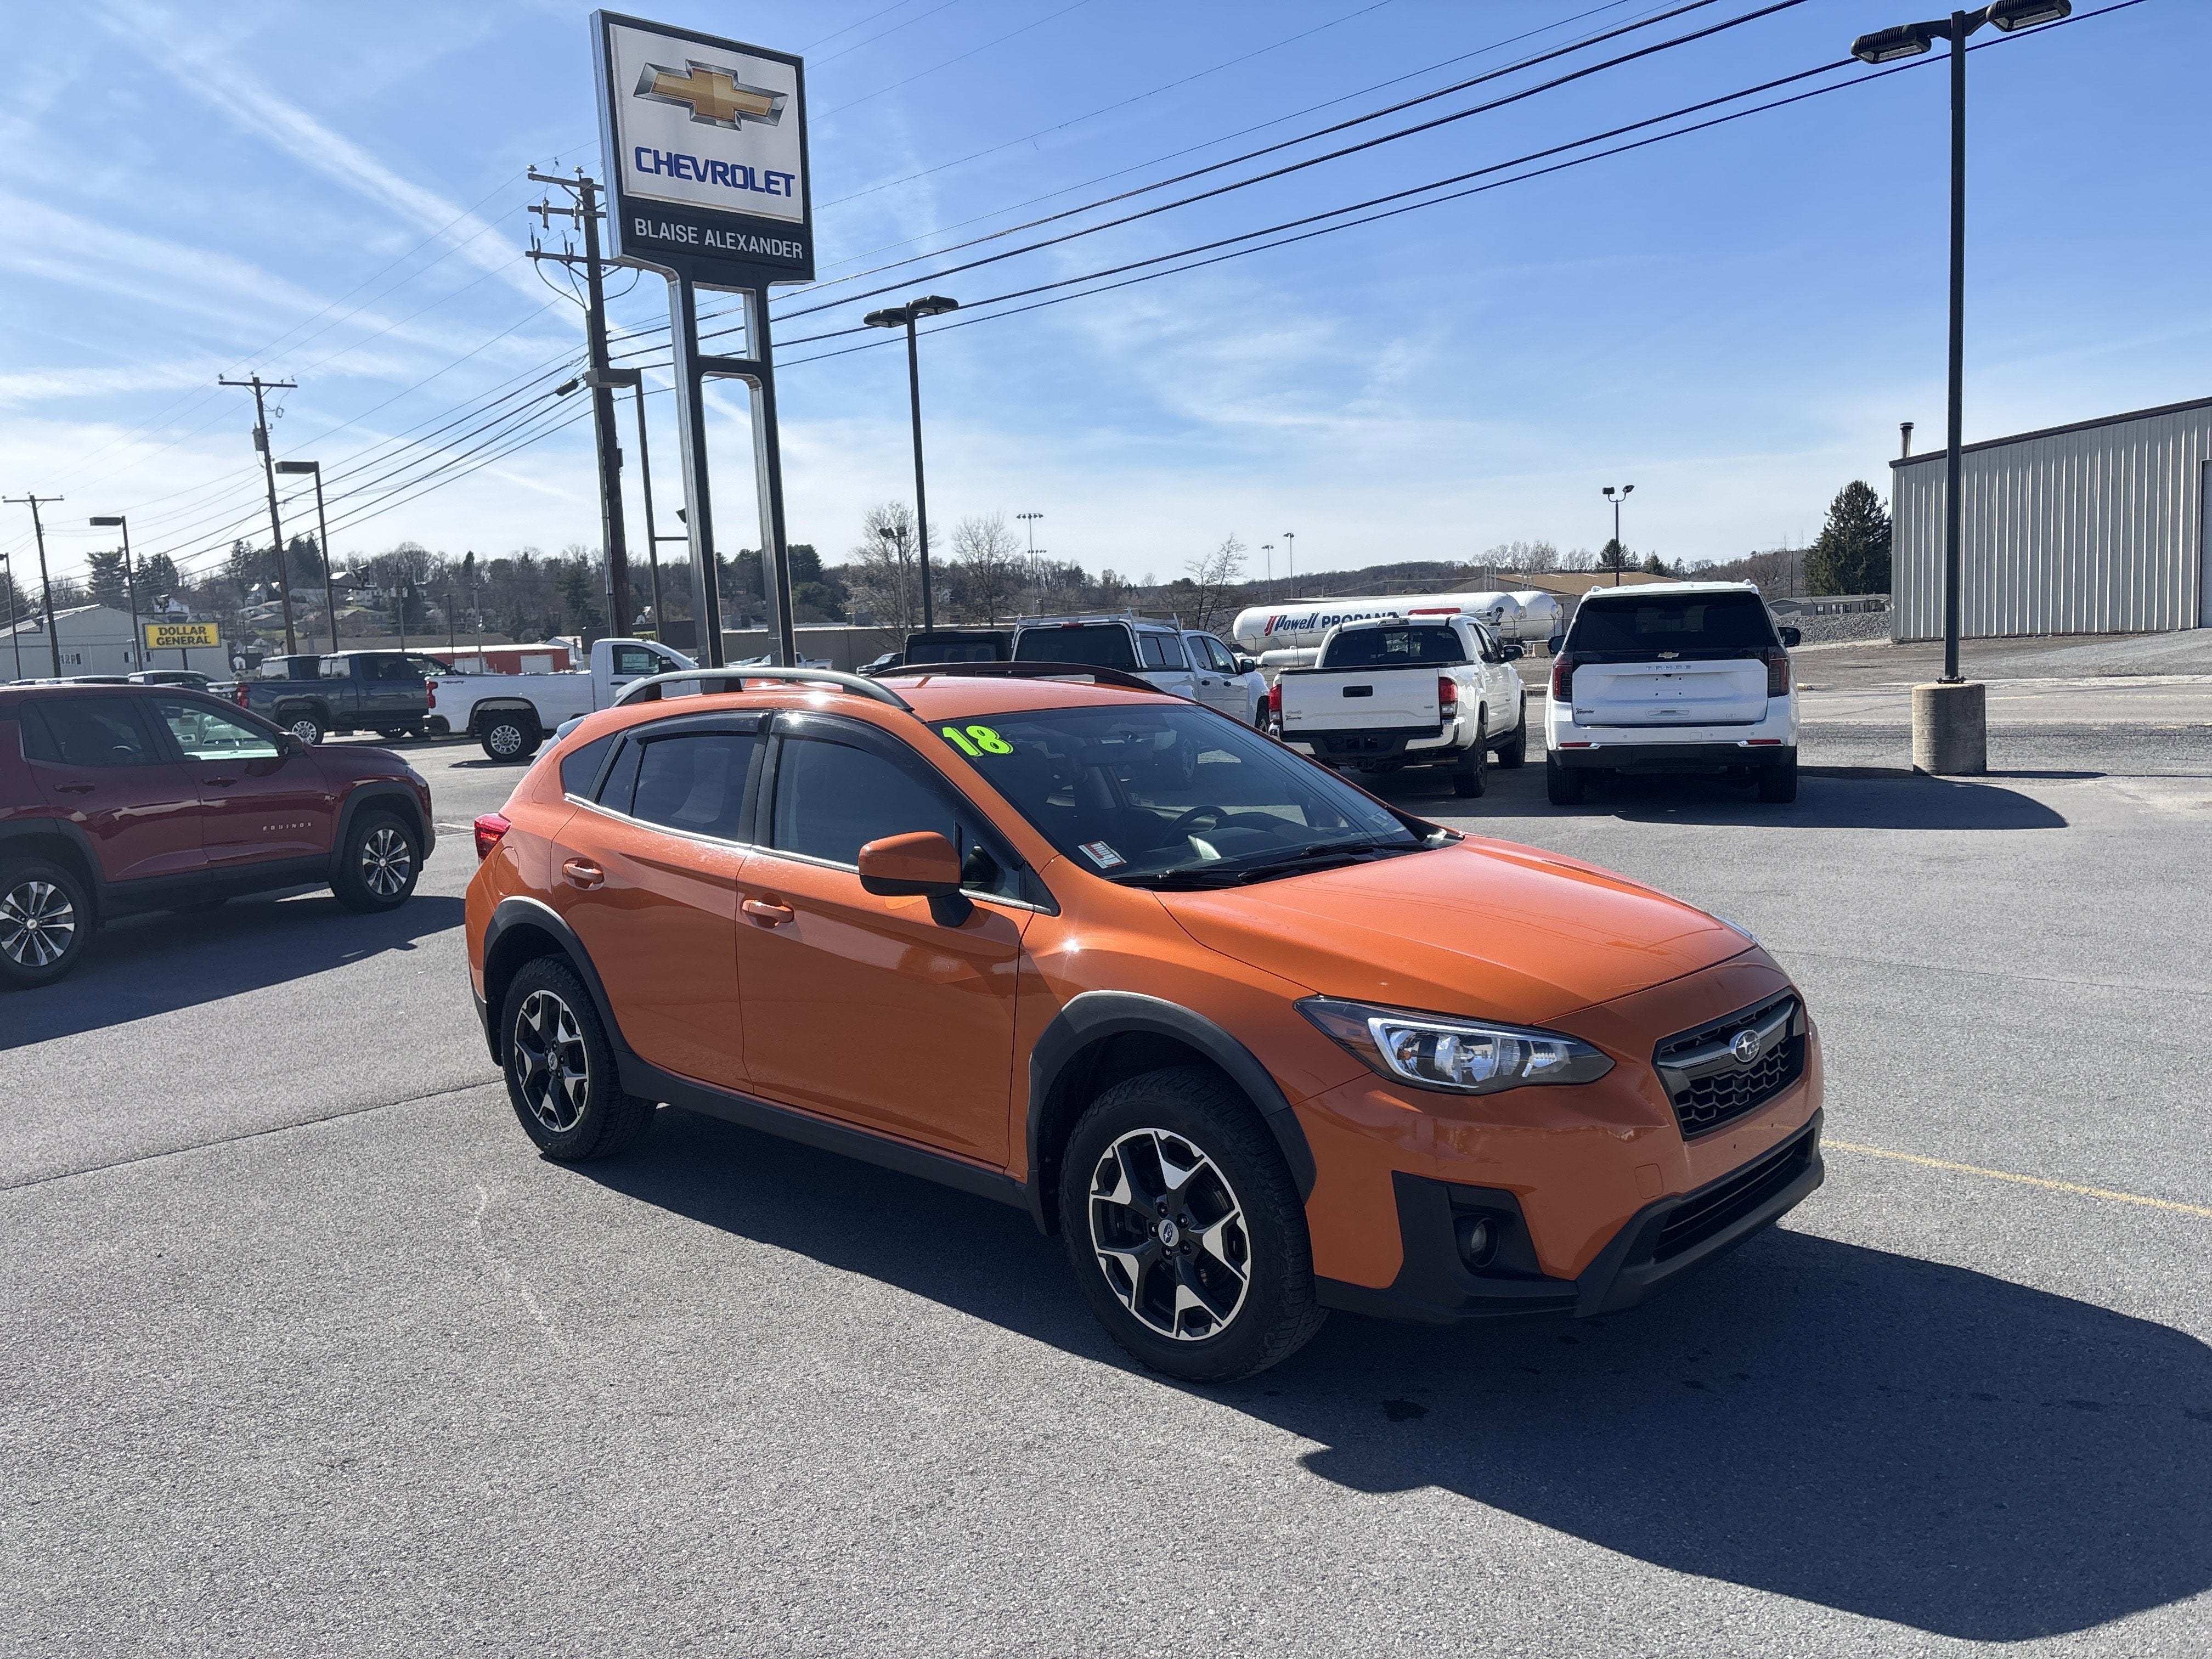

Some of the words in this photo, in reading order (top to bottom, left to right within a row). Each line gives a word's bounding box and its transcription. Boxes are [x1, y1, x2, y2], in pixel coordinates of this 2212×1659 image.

[635, 146, 795, 198] CHEVROLET
[635, 218, 698, 245] BLAISE
[704, 229, 803, 259] ALEXANDER
[158, 627, 207, 635] DOLLAR
[1274, 612, 1320, 631] Powell
[156, 636, 211, 645] GENERAL
[943, 725, 1013, 757] 18
[263, 822, 311, 831] EQUINOX
